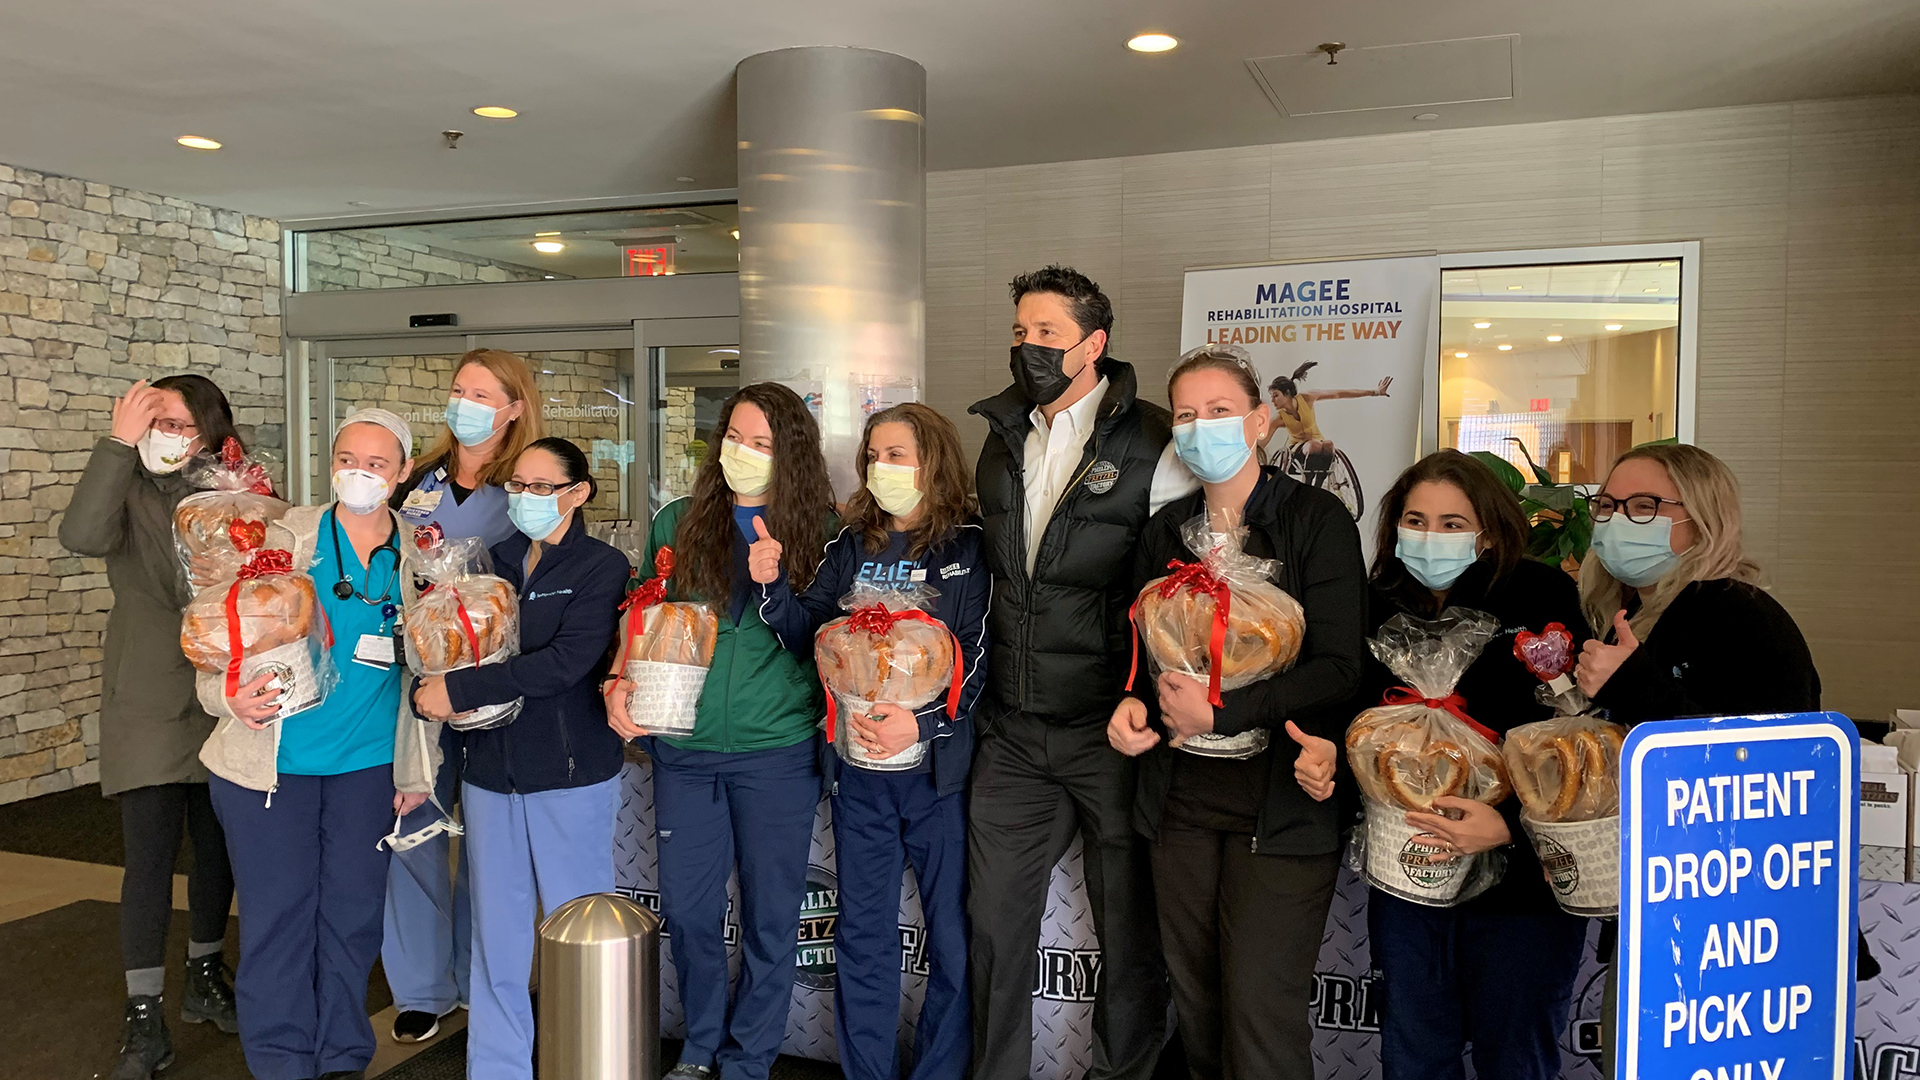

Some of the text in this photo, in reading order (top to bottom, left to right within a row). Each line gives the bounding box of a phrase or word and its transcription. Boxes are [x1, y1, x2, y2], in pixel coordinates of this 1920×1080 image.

[1256, 279, 1350, 304] MAGEE
[1208, 302, 1402, 321] REHABILITATION HOSPITAL
[1207, 321, 1402, 345] LEADING THE WAY
[543, 404, 626, 417] Rehabilitation
[1667, 770, 1815, 826] PATIENT
[1648, 841, 1833, 903] DROP OFF
[1700, 918, 1778, 970] AND
[1664, 985, 1812, 1048] PICK UP
